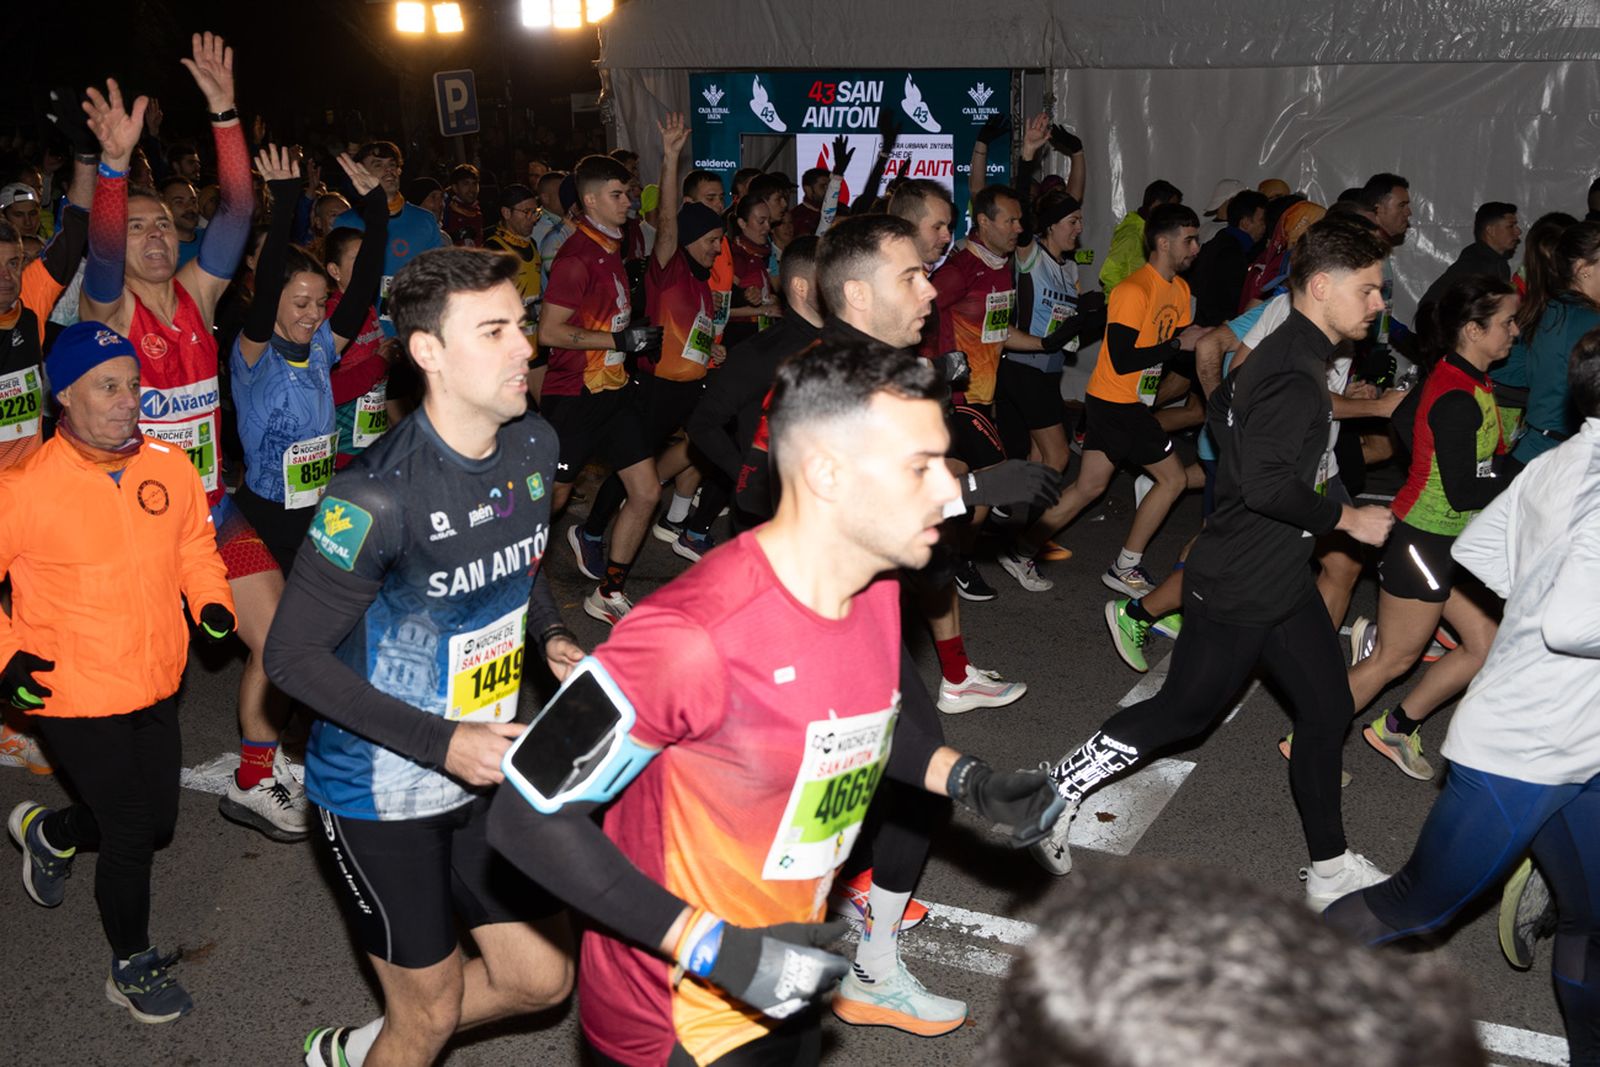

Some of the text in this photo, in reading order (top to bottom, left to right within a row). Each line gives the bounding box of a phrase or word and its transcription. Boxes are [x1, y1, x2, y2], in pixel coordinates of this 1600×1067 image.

[445, 79, 469, 128] P
[808, 81, 884, 105] 43 SAN
[760, 106, 775, 123] 43
[802, 101, 881, 128] ANTÓN
[913, 106, 929, 123] 43
[695, 159, 737, 168] calderón
[884, 160, 910, 176] AN
[956, 163, 1005, 173] carón
[427, 557, 486, 598] SAN
[471, 647, 524, 699] 1449
[814, 761, 880, 825] 4669
